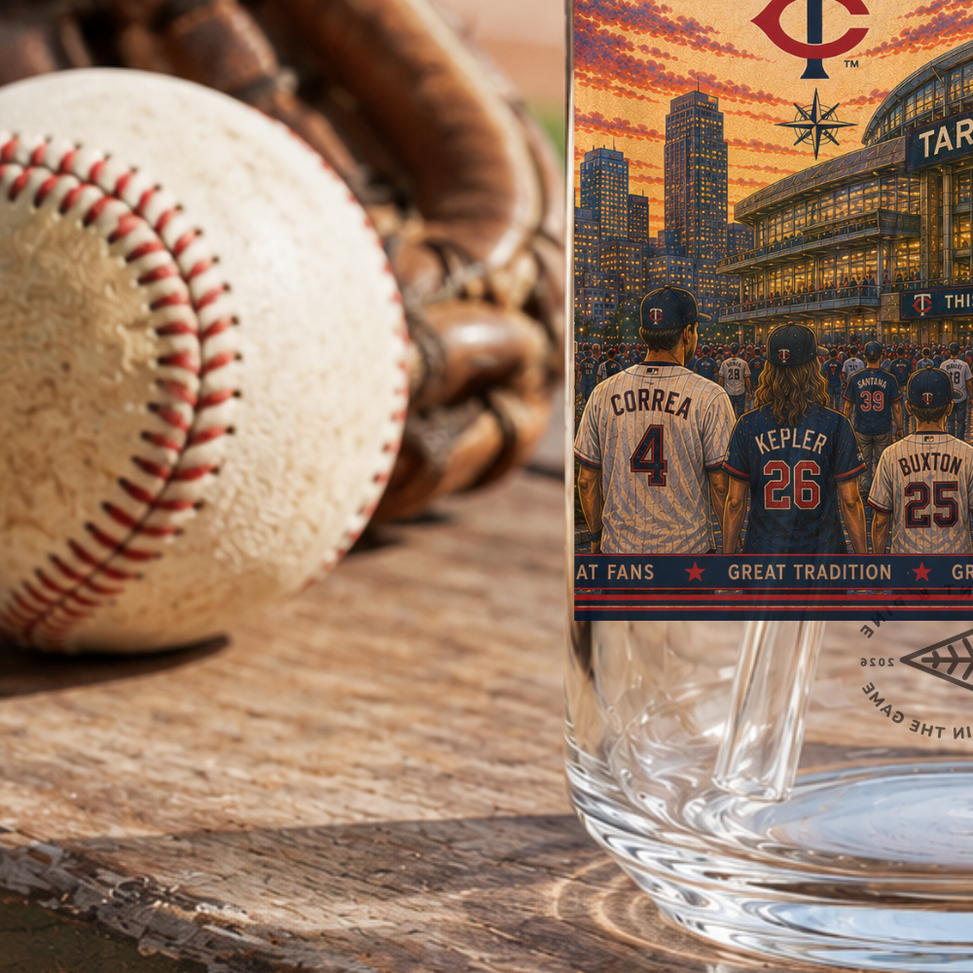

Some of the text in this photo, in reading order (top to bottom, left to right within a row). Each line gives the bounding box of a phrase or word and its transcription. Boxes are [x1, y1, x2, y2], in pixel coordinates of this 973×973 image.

[610, 388, 692, 421] CORREA
[859, 390, 884, 413] 39
[630, 424, 668, 487] 4
[755, 428, 827, 455] KEPLER
[897, 452, 963, 478] BUXTON
[763, 460, 821, 510] 26
[904, 480, 959, 528] 25
[608, 564, 655, 580] FANS
[728, 564, 787, 580] GREAT
[794, 564, 891, 580] TRADITION
